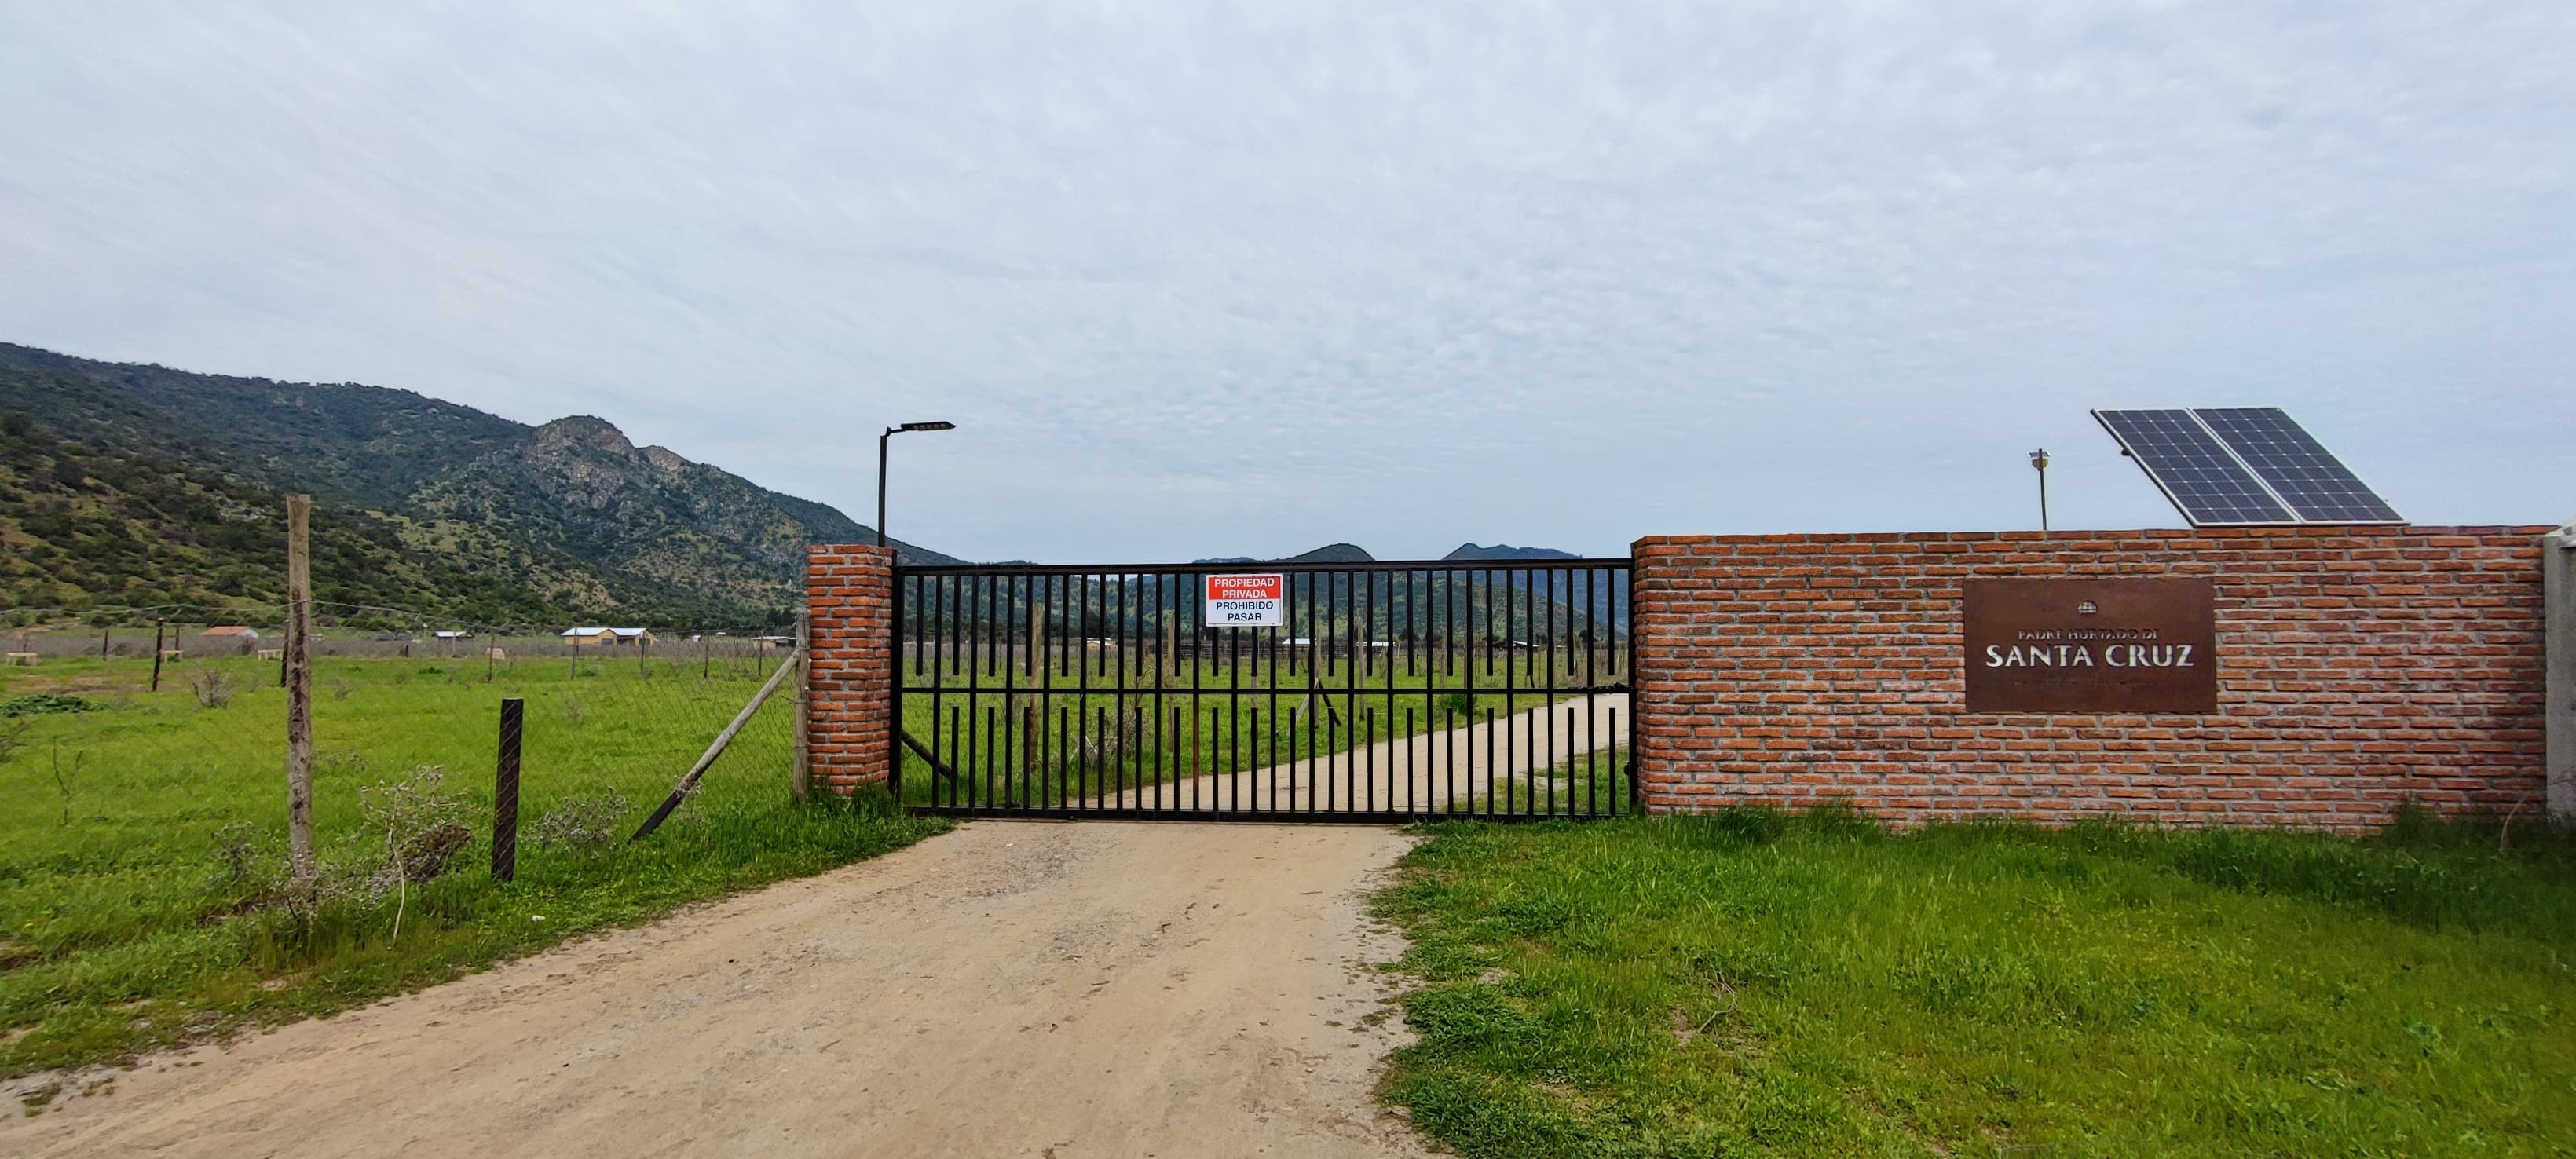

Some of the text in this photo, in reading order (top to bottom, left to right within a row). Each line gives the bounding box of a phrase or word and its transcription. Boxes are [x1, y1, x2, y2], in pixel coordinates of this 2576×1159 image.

[1214, 578, 1275, 587] PROPIEDAD
[1222, 590, 1268, 598] PRIVADA
[1216, 601, 1274, 610] PROHIBIDO
[1228, 612, 1262, 621] PASAR
[2018, 628, 2062, 640] PADRE
[1985, 644, 2194, 667] SANTA CRUZ
